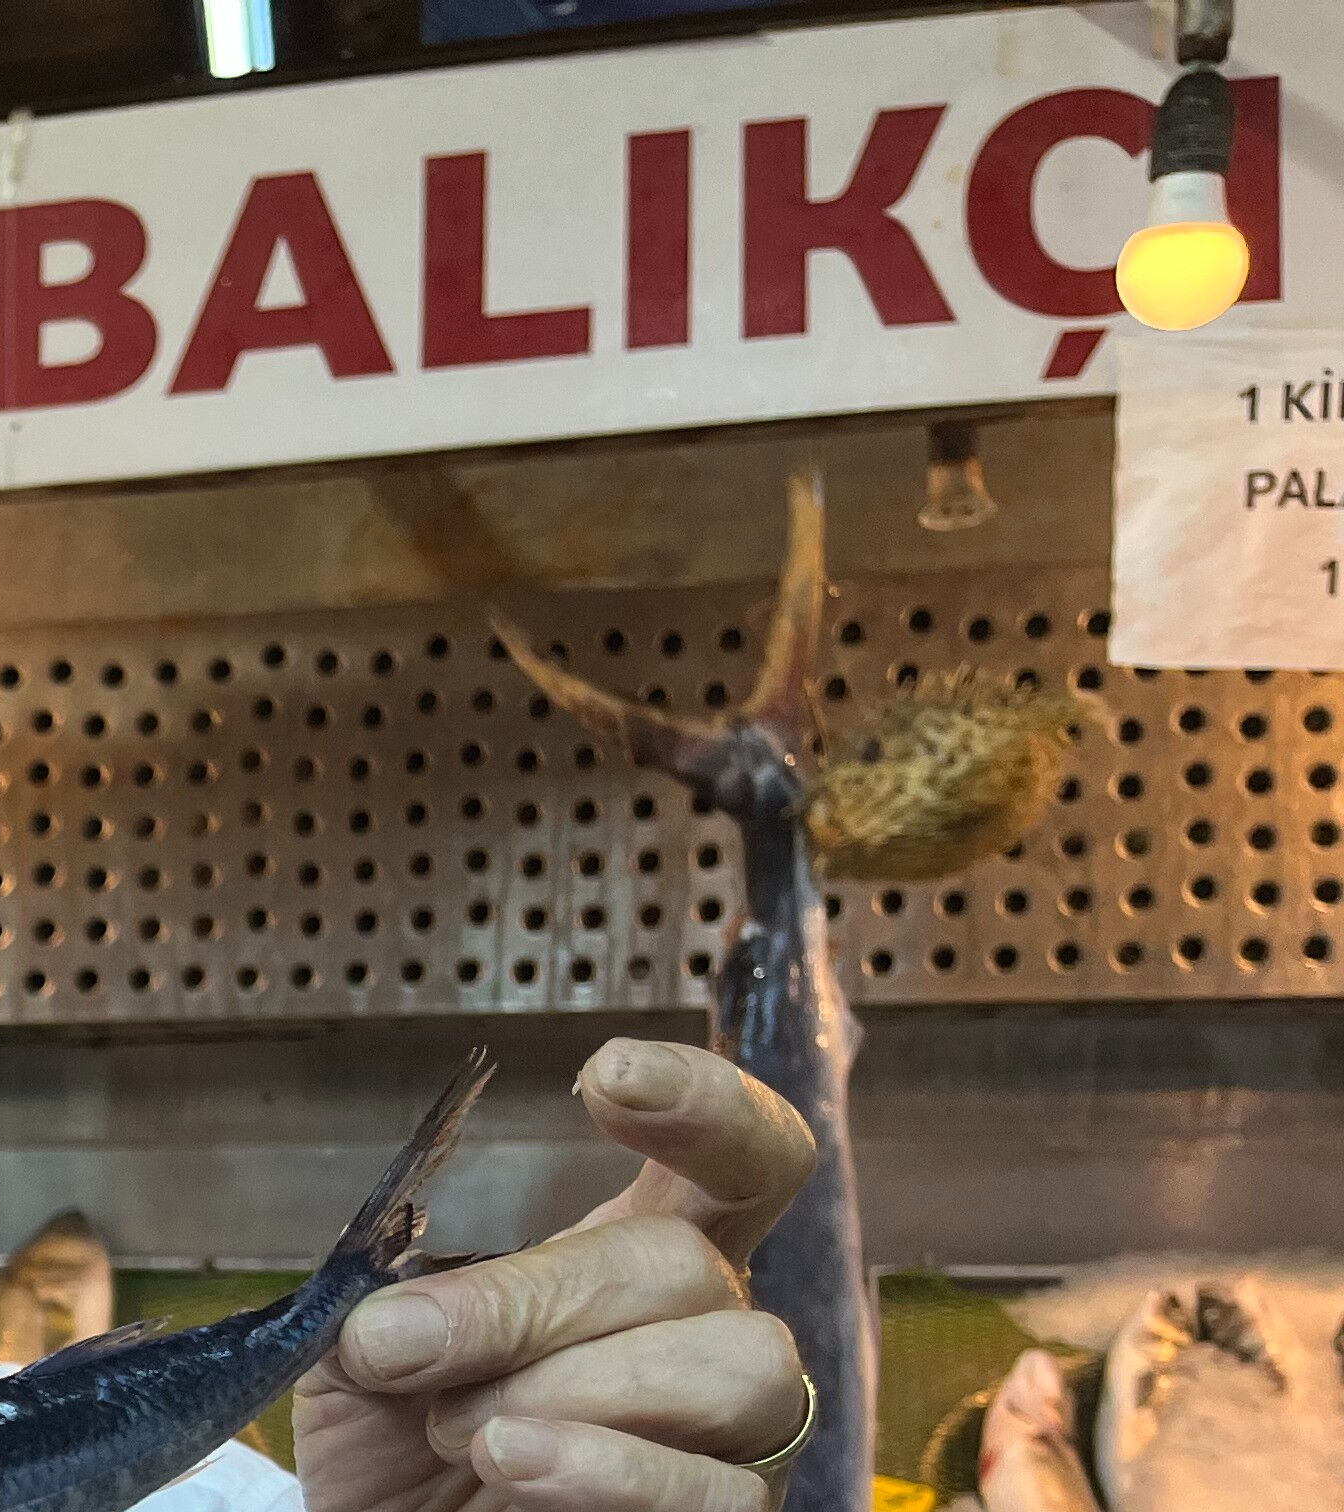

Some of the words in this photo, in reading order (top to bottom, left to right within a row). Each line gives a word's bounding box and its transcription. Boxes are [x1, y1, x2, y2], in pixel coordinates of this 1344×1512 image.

[1237, 383, 1259, 423] 1
[1282, 368, 1344, 422] Kİ
[1244, 467, 1344, 509] PAL
